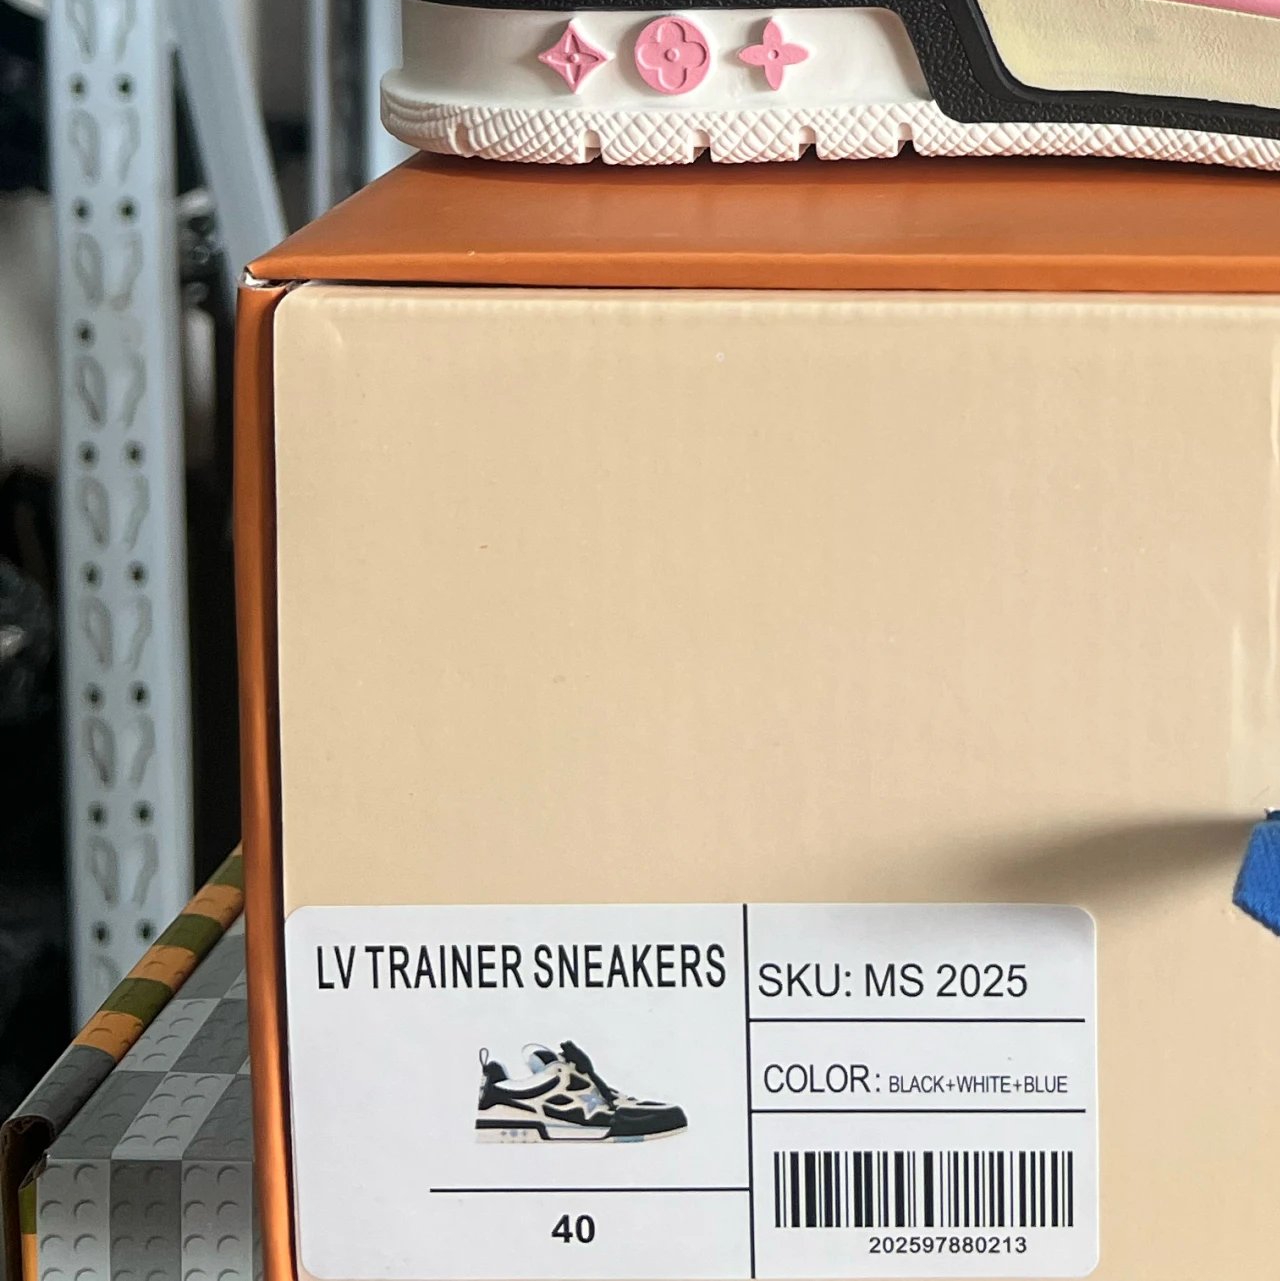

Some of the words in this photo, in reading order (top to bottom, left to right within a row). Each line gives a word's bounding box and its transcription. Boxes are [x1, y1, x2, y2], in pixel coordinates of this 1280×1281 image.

[316, 944, 356, 990] LV
[364, 944, 525, 990] TRAINER
[533, 943, 727, 989] SNEAKERS
[758, 962, 852, 998] SKU:
[865, 962, 924, 998] MS
[936, 962, 1028, 998] 2025
[763, 1063, 881, 1094] COLOR:
[888, 1074, 1068, 1094] BLACK+WHITE+BLUE
[550, 1213, 597, 1245] 40
[868, 1235, 1028, 1255] 202597880213
